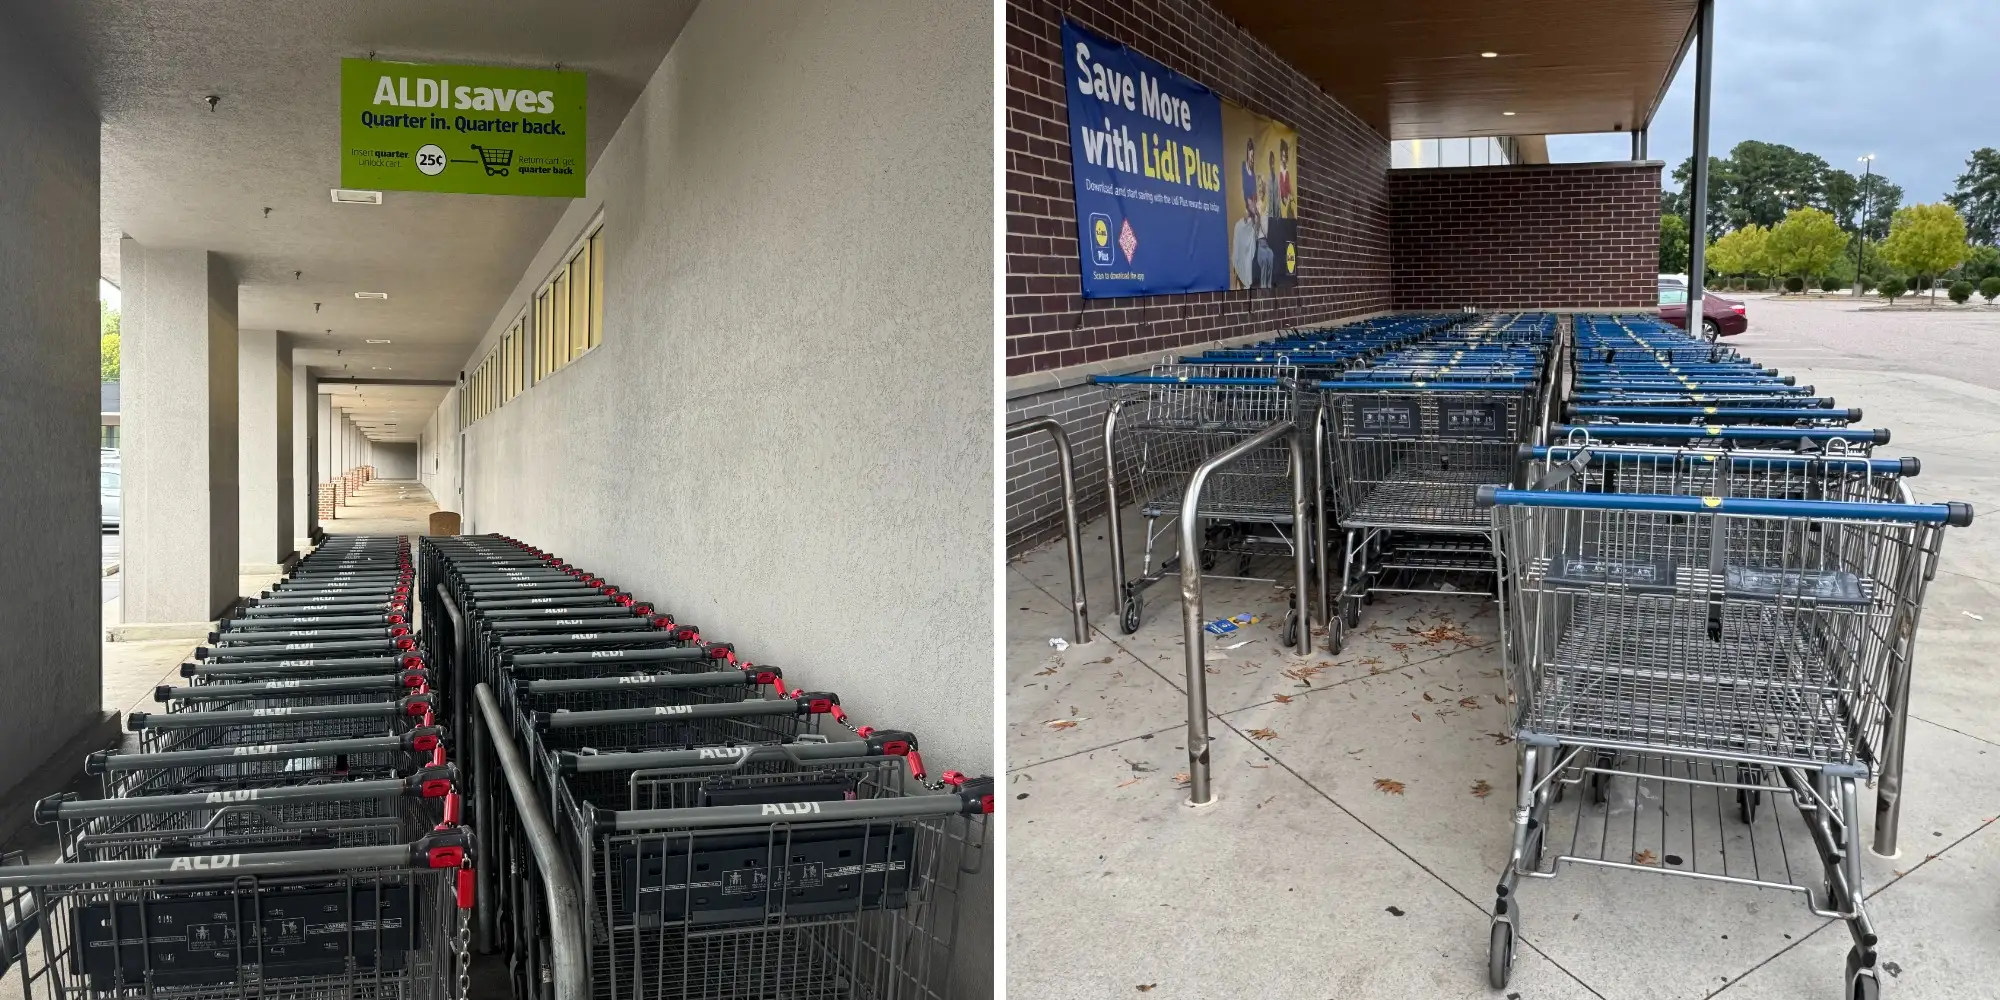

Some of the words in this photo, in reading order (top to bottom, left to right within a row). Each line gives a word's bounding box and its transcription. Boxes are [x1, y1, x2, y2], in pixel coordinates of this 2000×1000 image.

[1076, 42, 1136, 111] Save
[1141, 71, 1192, 131] More
[373, 76, 449, 109] ALDI
[454, 86, 554, 114] saves
[361, 110, 427, 129] Quarter
[430, 112, 451, 130] in.
[455, 115, 519, 133] Quarter
[522, 118, 566, 135] back.
[351, 148, 373, 156] Insert
[1081, 116, 1138, 175] with
[1141, 132, 1181, 184] Lidl
[1183, 145, 1220, 192] Plus
[420, 154, 443, 166] 25¢
[519, 156, 544, 164] Return
[519, 166, 551, 174] quarter
[1085, 178, 1114, 195] Download
[1114, 186, 1126, 197] and
[1127, 188, 1138, 199] start
[1138, 190, 1153, 204] saving
[1154, 193, 1164, 203] with
[1163, 194, 1171, 204] the
[1098, 250, 1109, 261] Plus
[1093, 270, 1104, 280] Scan
[1104, 272, 1110, 280] to
[1110, 271, 1130, 280] download
[1137, 273, 1145, 282] app
[592, 650, 624, 658] ALDI
[266, 680, 300, 689] ALDI
[619, 675, 656, 684] ALDI
[253, 707, 292, 717] ALDI
[655, 705, 693, 715] ALDI
[233, 745, 278, 756] ALDI
[205, 789, 258, 803] ALDI
[761, 801, 821, 816] ALDI
[169, 854, 240, 872] ALDI
